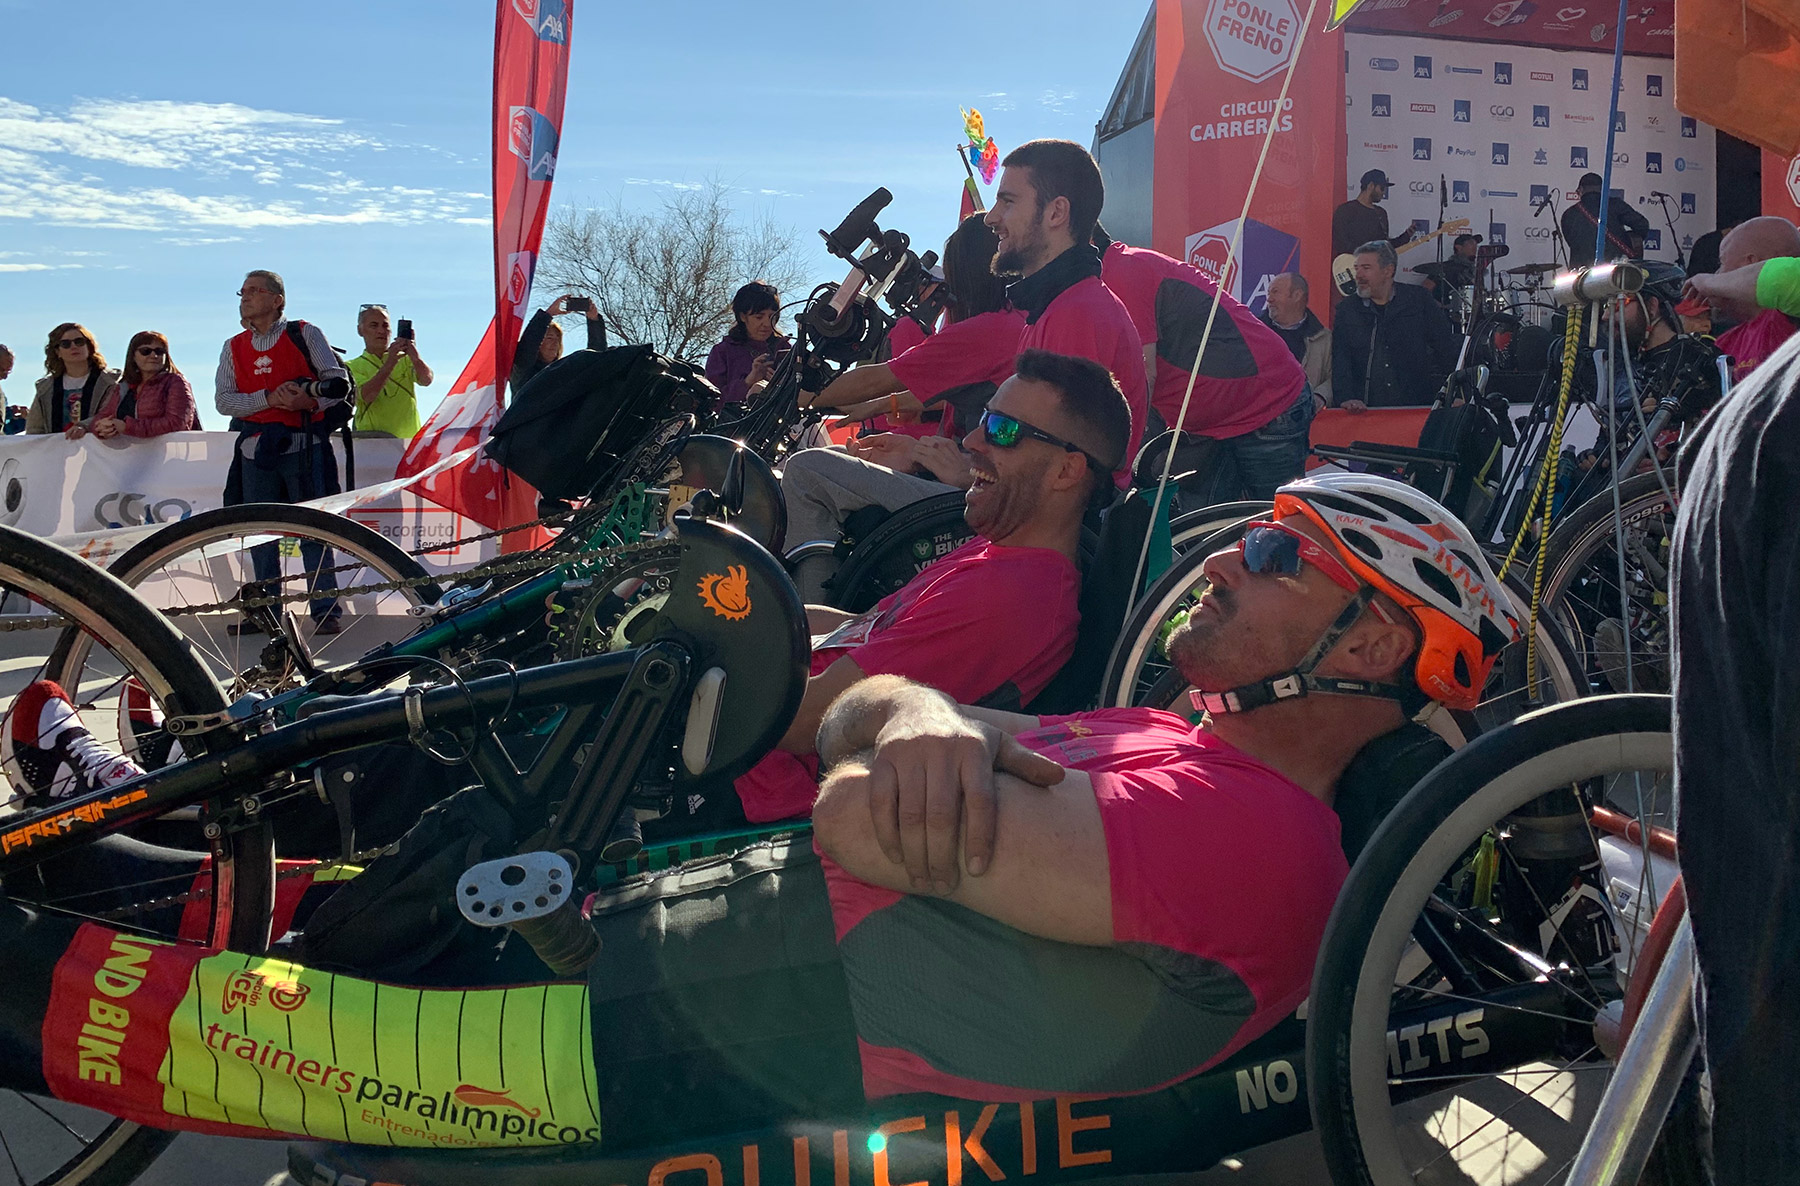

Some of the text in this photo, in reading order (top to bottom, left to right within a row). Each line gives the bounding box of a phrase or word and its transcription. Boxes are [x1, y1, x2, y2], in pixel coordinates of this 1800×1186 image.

[1222, 0, 1290, 37] PONLE
[539, 14, 565, 41] AXA
[1217, 15, 1284, 55] FRENO
[1414, 67, 1430, 78] AXA
[1531, 73, 1553, 81] MOTUL
[1494, 73, 1509, 84] AXA
[1573, 80, 1586, 90] AXA
[1647, 86, 1660, 96] AXA
[1372, 105, 1388, 117] AXA
[1411, 104, 1435, 112] MOTUL
[1454, 111, 1468, 121] AXA
[1533, 116, 1547, 126] AXA
[1190, 114, 1294, 142] CARRERAS
[1681, 127, 1694, 138] AXA
[1413, 149, 1428, 160] AXA
[1455, 148, 1476, 157] PayPal
[1492, 154, 1506, 164] AXA
[1570, 157, 1586, 167] AXA
[1646, 162, 1660, 173] AXA
[1453, 192, 1467, 202] AXA
[1681, 203, 1694, 213] AXA
[1645, 240, 1660, 249] AXA
[1193, 253, 1227, 277] PONLE
[934, 532, 952, 542] THE
[77, 998, 130, 1085] BIKE
[1236, 1060, 1297, 1114] NO
